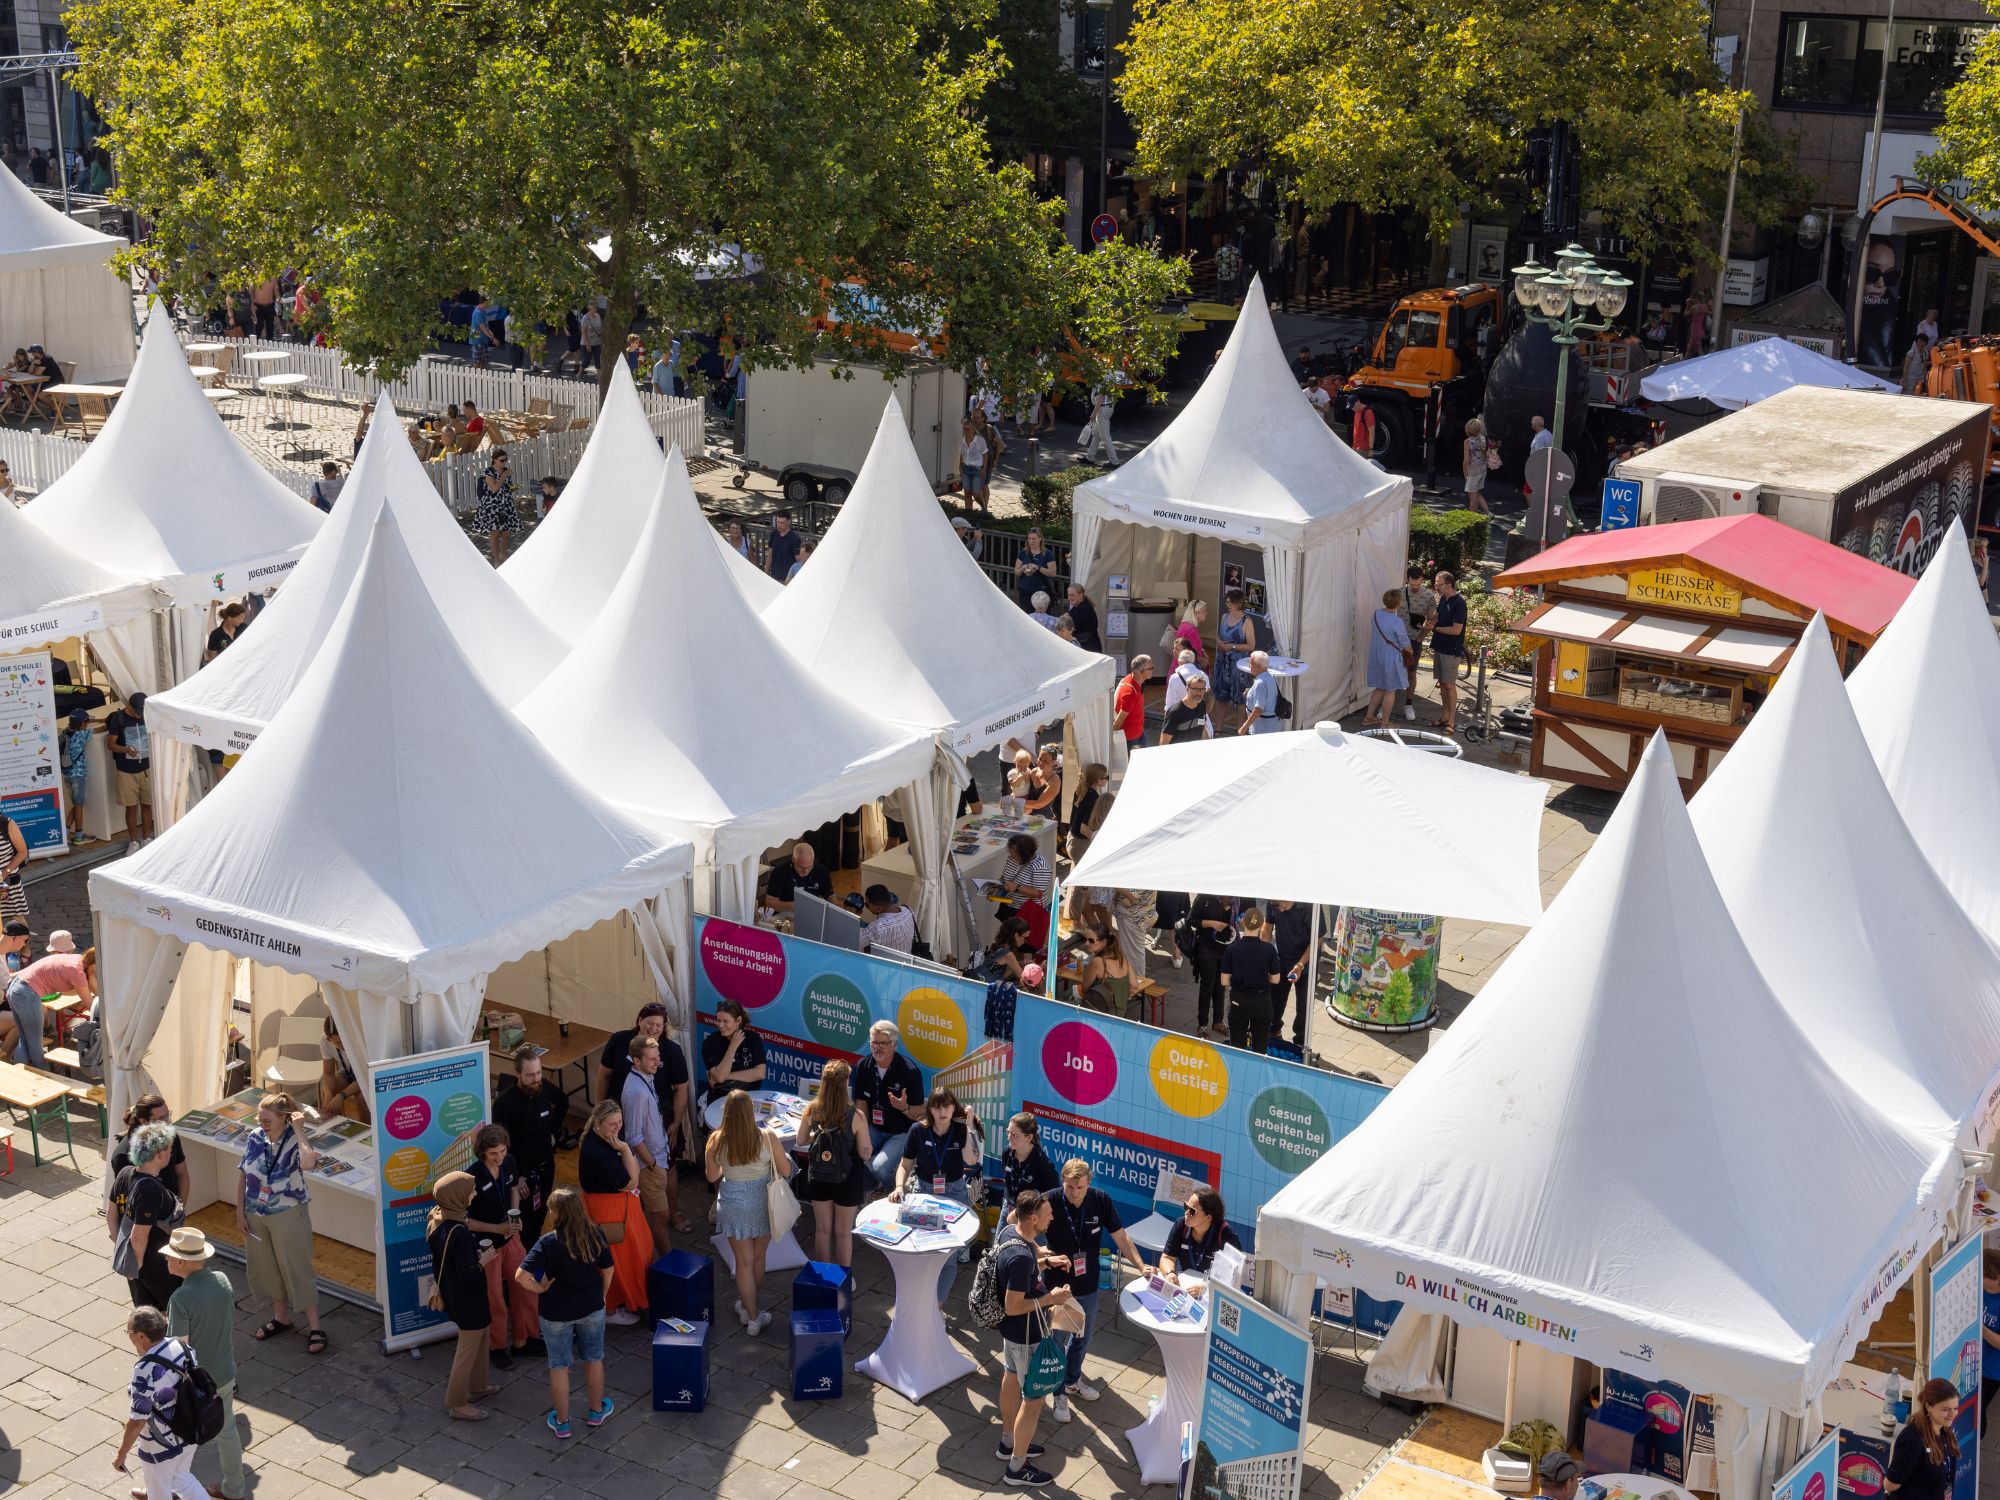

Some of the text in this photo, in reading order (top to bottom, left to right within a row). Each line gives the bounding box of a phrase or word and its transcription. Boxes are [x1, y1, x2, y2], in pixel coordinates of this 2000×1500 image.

[1611, 487, 1633, 502] WC
[1867, 467, 1909, 507] Markenreifen
[1153, 508, 1227, 529] WOCHEN DER DEMENZ
[1655, 572, 1715, 592] HEISSER
[1636, 584, 1732, 610] SCHAFSKÄSE
[0, 619, 59, 639] ÜR DIE SCHULE
[0, 662, 42, 673] DIE SCHULE!
[985, 699, 1047, 736] FACHBEREICH SOZIALES
[195, 917, 302, 958] GEDENKSTÄTTE AHLEM
[704, 936, 783, 965] Anerkennungsjahr
[713, 951, 774, 975] Soziale Arbeit
[810, 989, 865, 1014] Ausbildung,
[812, 1002, 862, 1026] Praktikum,
[913, 1009, 953, 1030] Duales
[907, 1024, 958, 1048] Studium
[766, 1049, 825, 1076] ANNOVE
[1064, 1051, 1094, 1074] Job
[1169, 1049, 1210, 1069] Quer-
[1159, 1066, 1218, 1096] einstieg
[1268, 1105, 1312, 1125] Gesund
[1254, 1117, 1324, 1144] arbeiten bei
[1092, 1139, 1178, 1174] HANNOVER
[1257, 1132, 1319, 1159] der Region
[1118, 1167, 1158, 1190] ARBE
[1455, 1277, 1518, 1306] REGION HANNOVER
[1396, 1270, 1578, 1344] DA WILL ICH ARBEITEN!
[1215, 1338, 1261, 1372] PERSPEKTIVE
[1213, 1354, 1264, 1392] BEGEISTERUNG
[1211, 1370, 1287, 1423] KOMMUNALGESTALTEN
